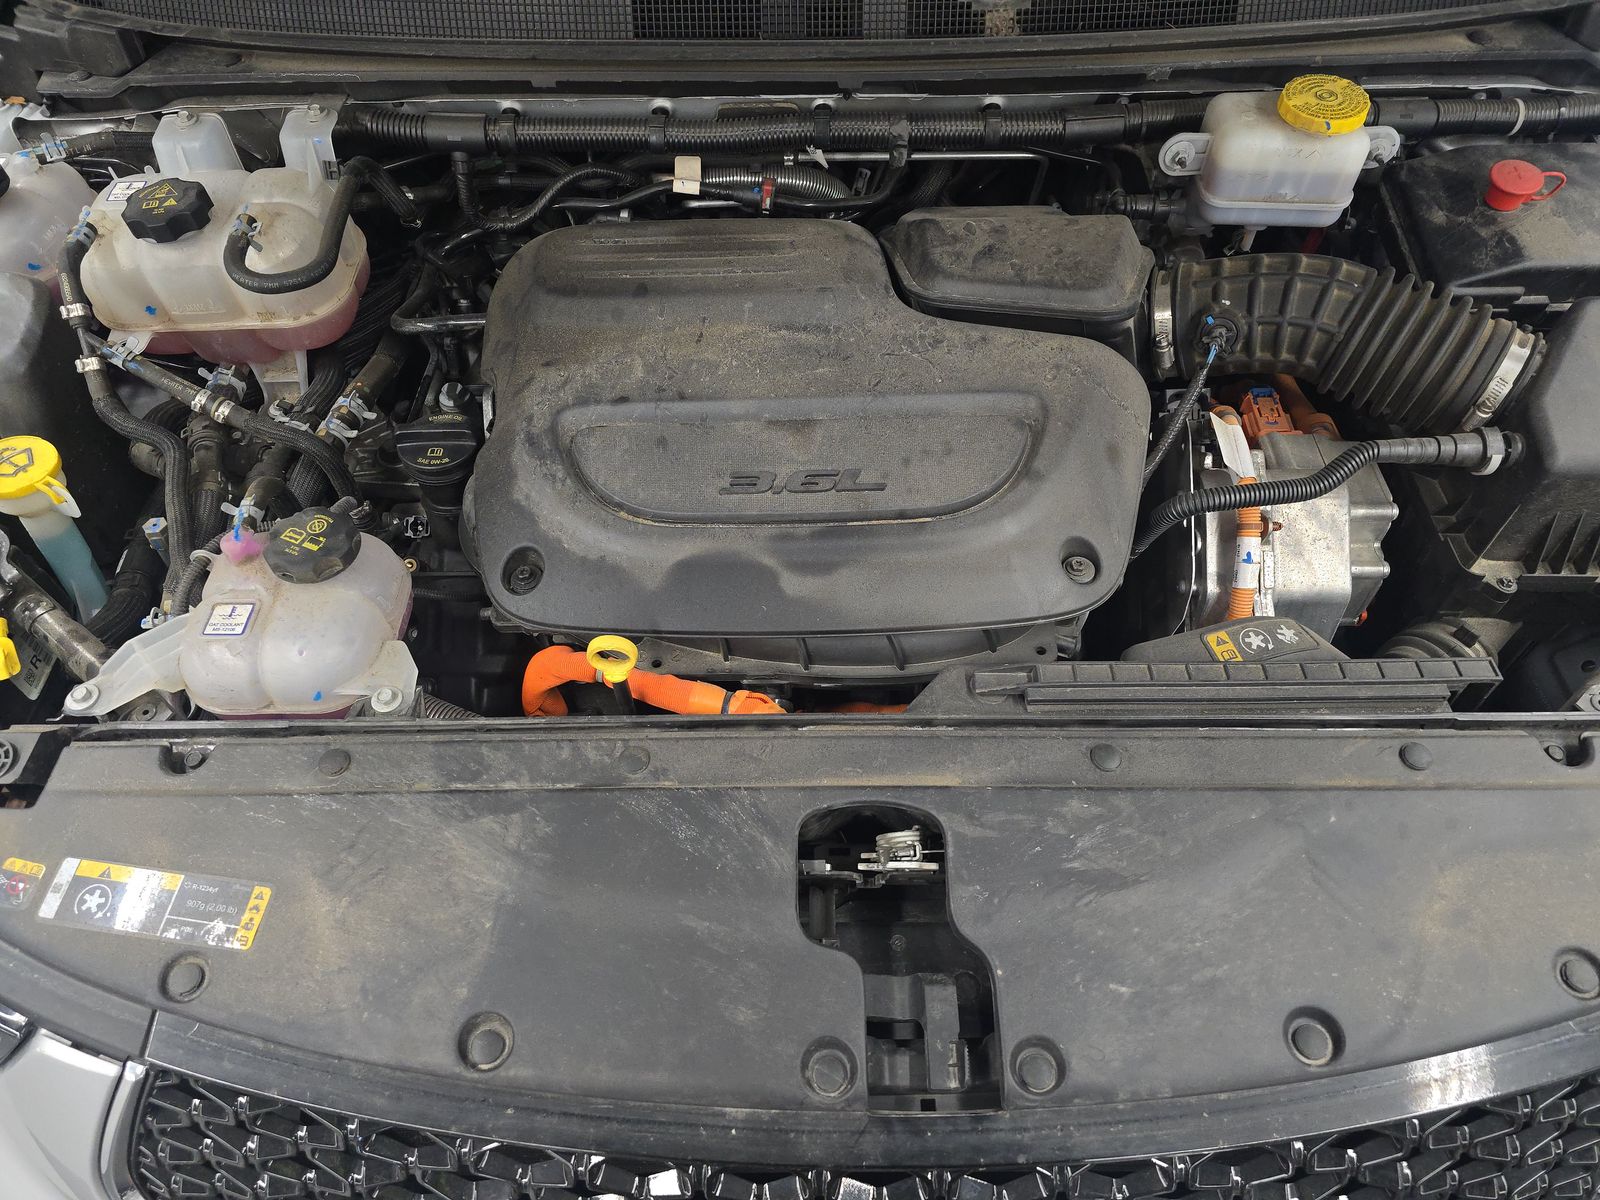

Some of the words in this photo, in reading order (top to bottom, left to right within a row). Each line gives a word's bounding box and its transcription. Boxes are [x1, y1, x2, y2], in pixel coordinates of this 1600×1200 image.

[232, 273, 259, 287] HEATER
[263, 281, 280, 289] 7MM
[718, 468, 888, 496] 3.6L
[29, 654, 42, 670] R
[192, 883, 219, 894] R-1234yf
[186, 900, 205, 912] 907g
[227, 906, 238, 915] lb)
